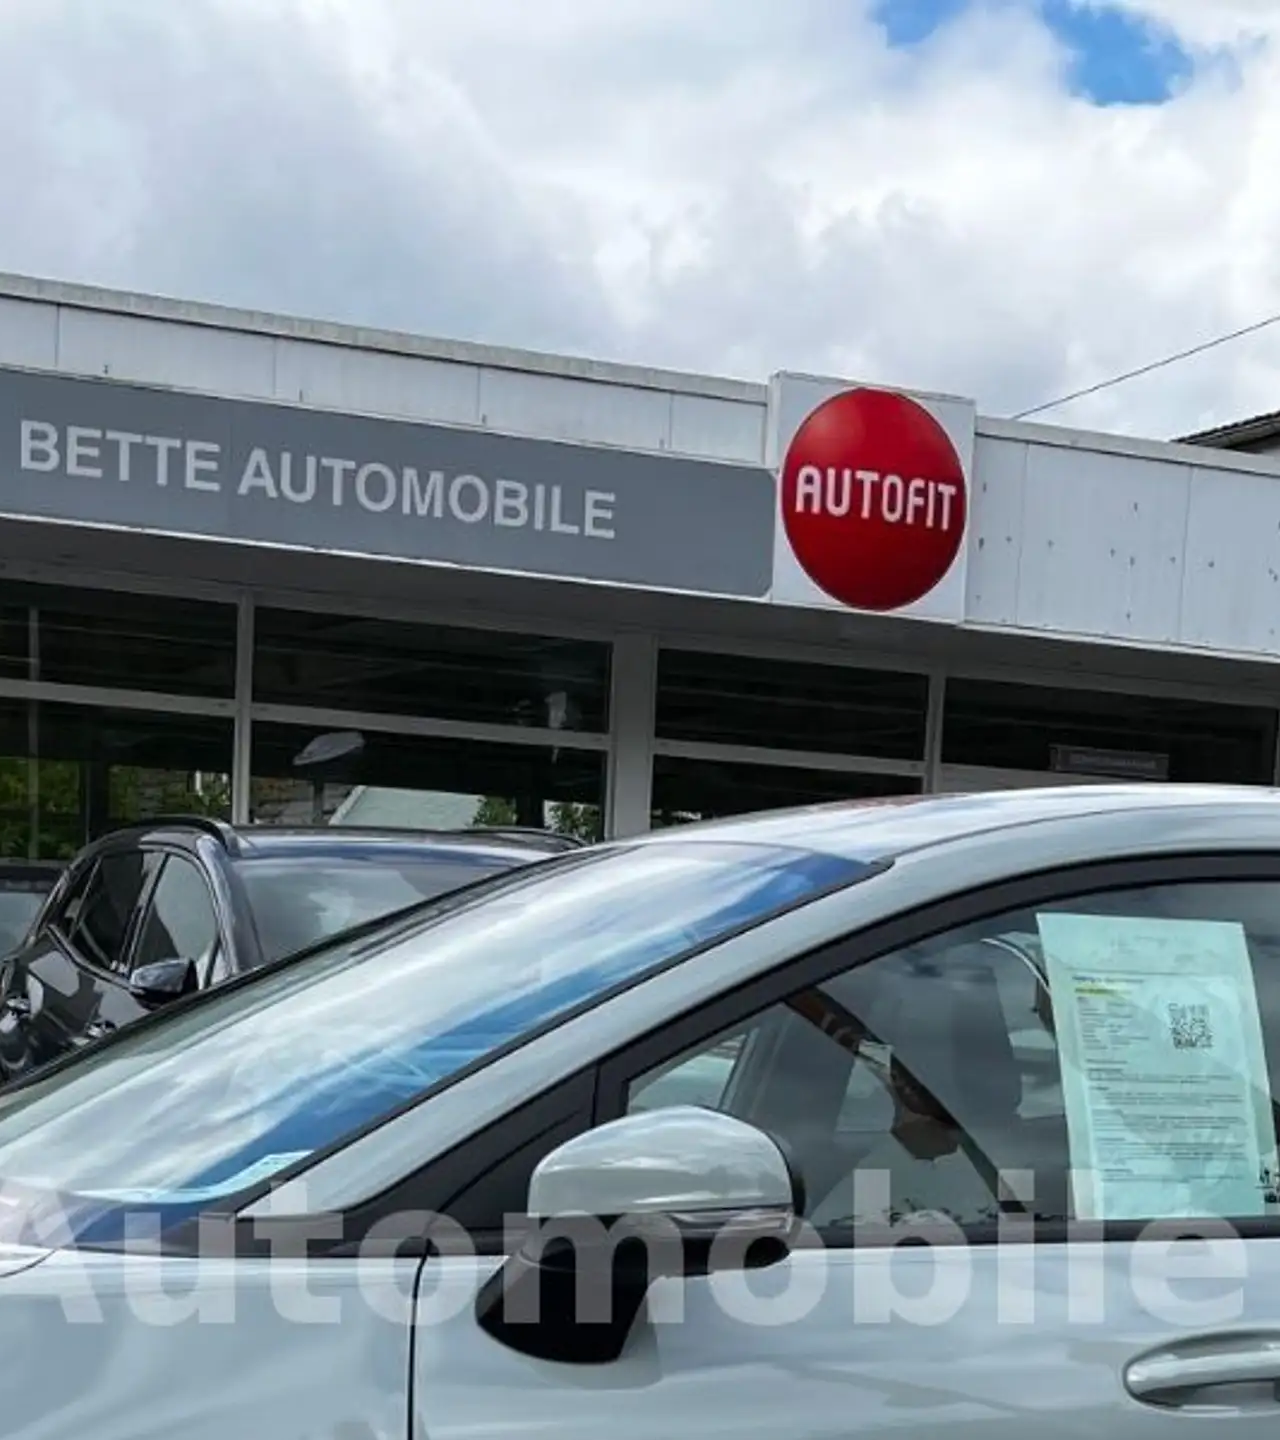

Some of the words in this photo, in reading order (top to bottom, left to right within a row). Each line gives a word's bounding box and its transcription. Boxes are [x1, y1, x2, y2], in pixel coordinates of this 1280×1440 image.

[19, 419, 221, 492] BETTE
[236, 446, 616, 540] AUTOMOBILE
[794, 464, 958, 532] AUTOFIT
